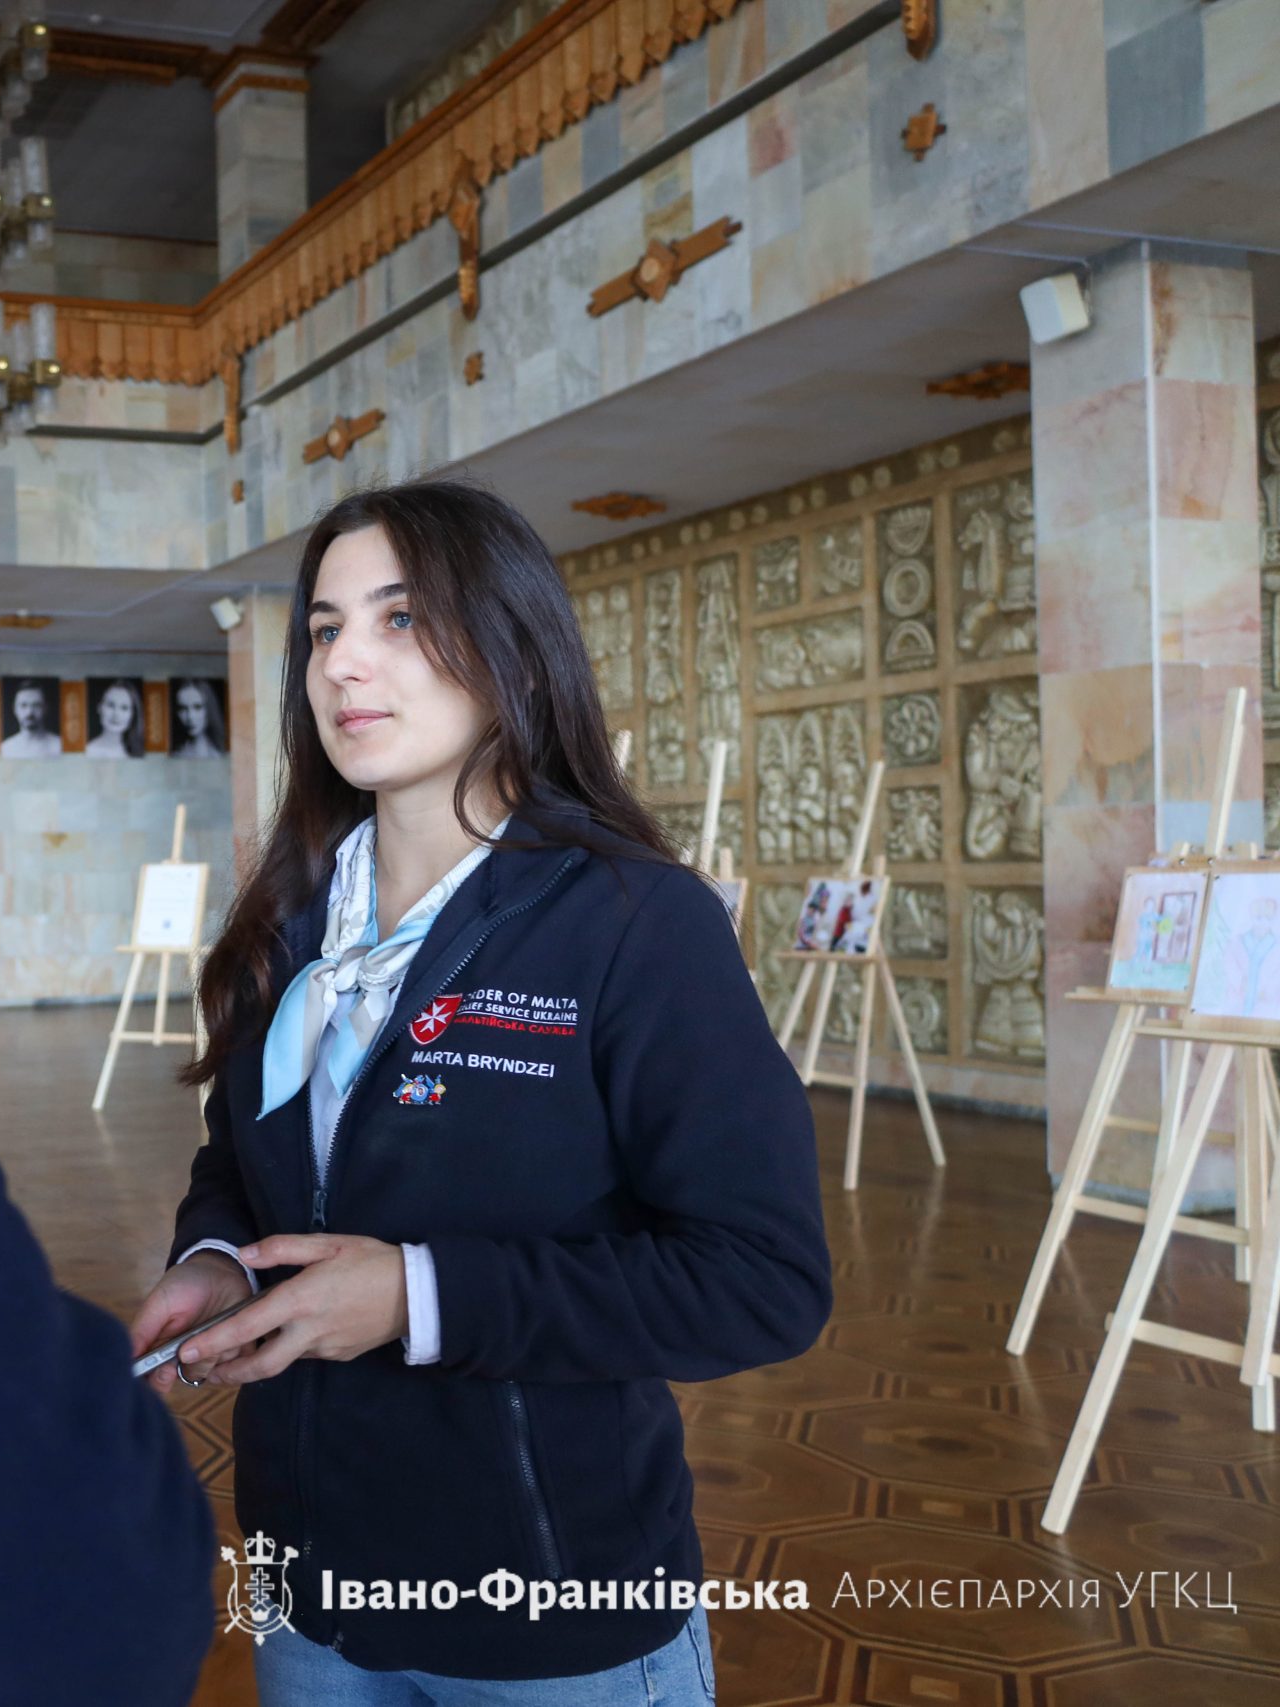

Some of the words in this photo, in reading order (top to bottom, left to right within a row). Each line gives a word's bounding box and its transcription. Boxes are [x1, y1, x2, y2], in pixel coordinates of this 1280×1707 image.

[466, 989, 503, 1002] DER
[508, 992, 528, 1004] OF
[531, 995, 578, 1009] MALTA
[456, 1002, 484, 1013] LIEF
[485, 1003, 530, 1018] SERVICE
[533, 1010, 578, 1022] UKRAINE
[528, 1024, 577, 1036] СЛУЖБА
[411, 1050, 463, 1066] MARTA
[467, 1054, 555, 1078] BRYNDZEI
